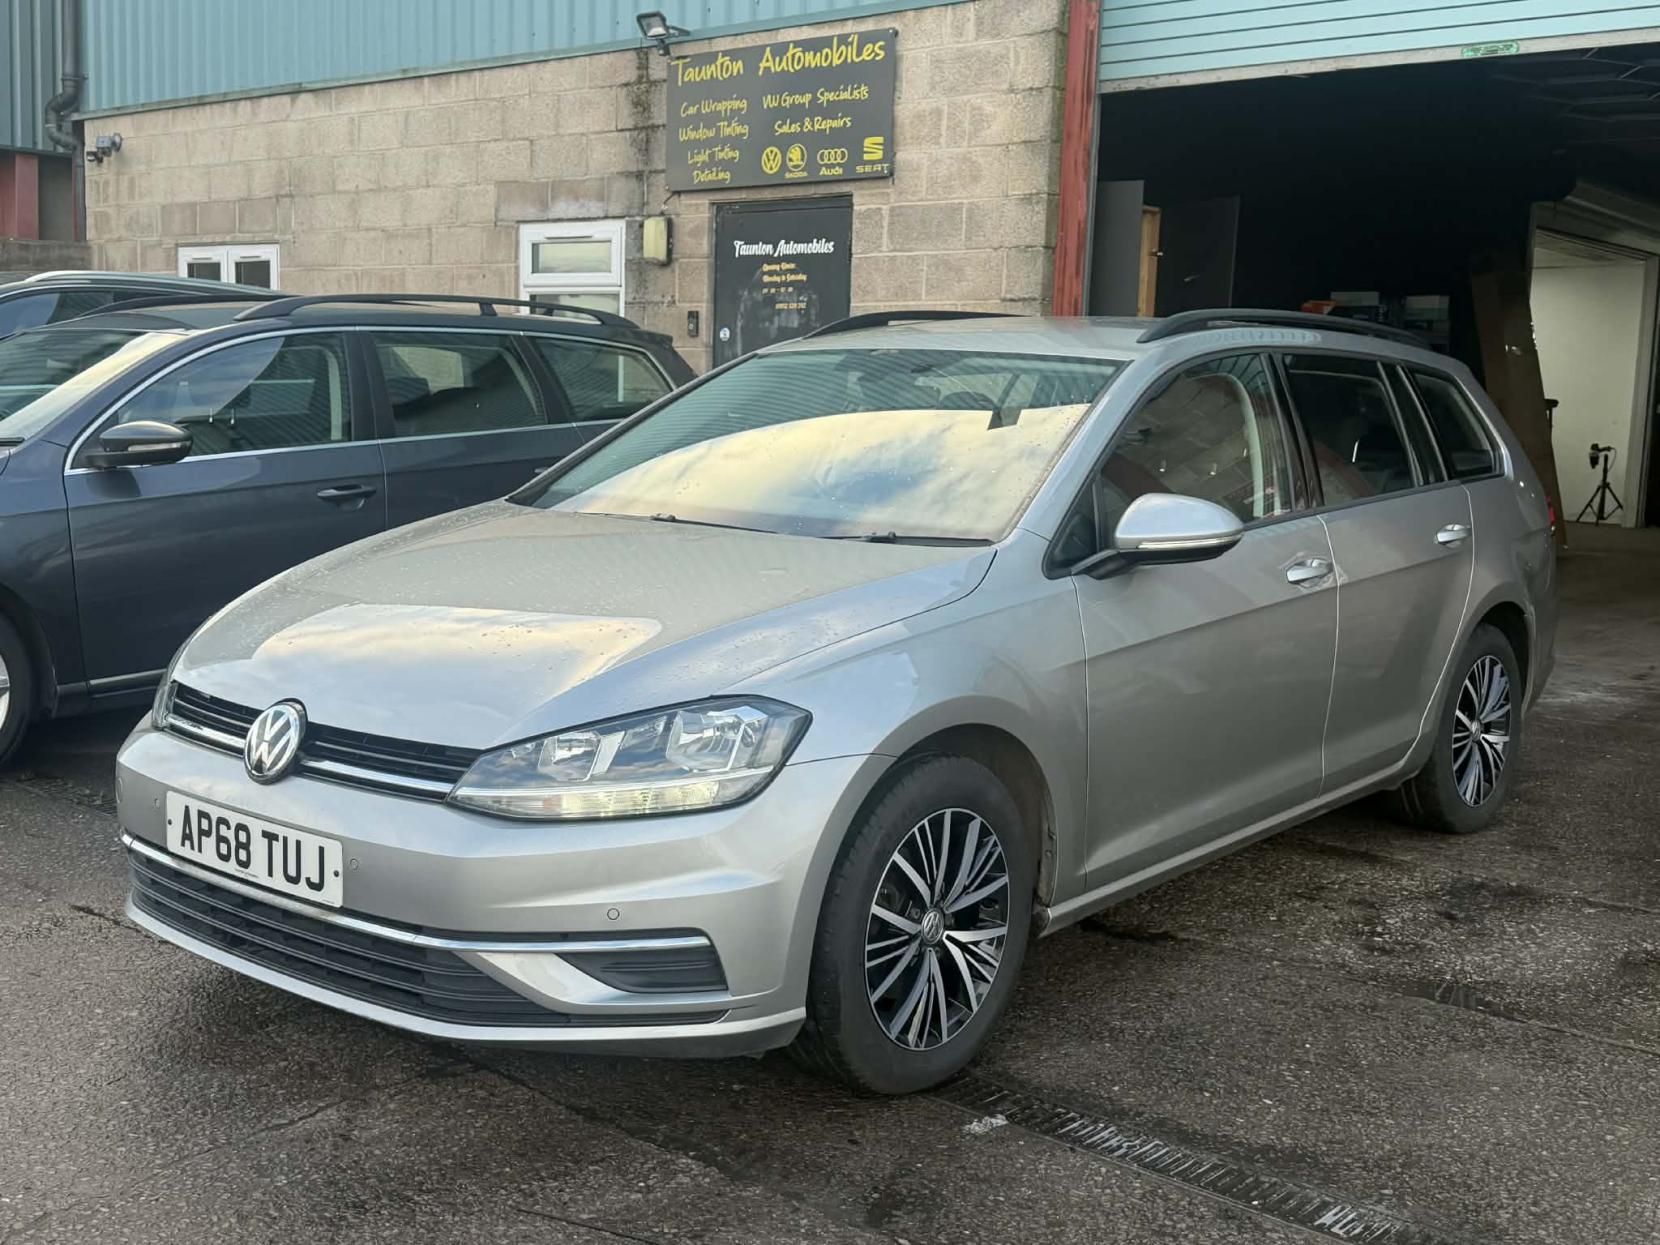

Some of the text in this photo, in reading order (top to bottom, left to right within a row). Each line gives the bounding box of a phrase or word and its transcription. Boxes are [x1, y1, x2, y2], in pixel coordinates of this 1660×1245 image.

[671, 34, 886, 86] Taunton Automobiles
[680, 94, 747, 117] Car Wrapping
[762, 94, 779, 109] VW
[781, 92, 812, 109] Group
[679, 117, 749, 142] Window Tinting
[774, 113, 852, 136] Sales & Repairs
[688, 148, 711, 167] Light
[693, 166, 731, 184] Detailing
[819, 166, 843, 176] Audi
[855, 164, 890, 174] SEAT
[733, 238, 834, 258] Taunton Automobiles
[180, 805, 325, 892] AP68 TUJ
